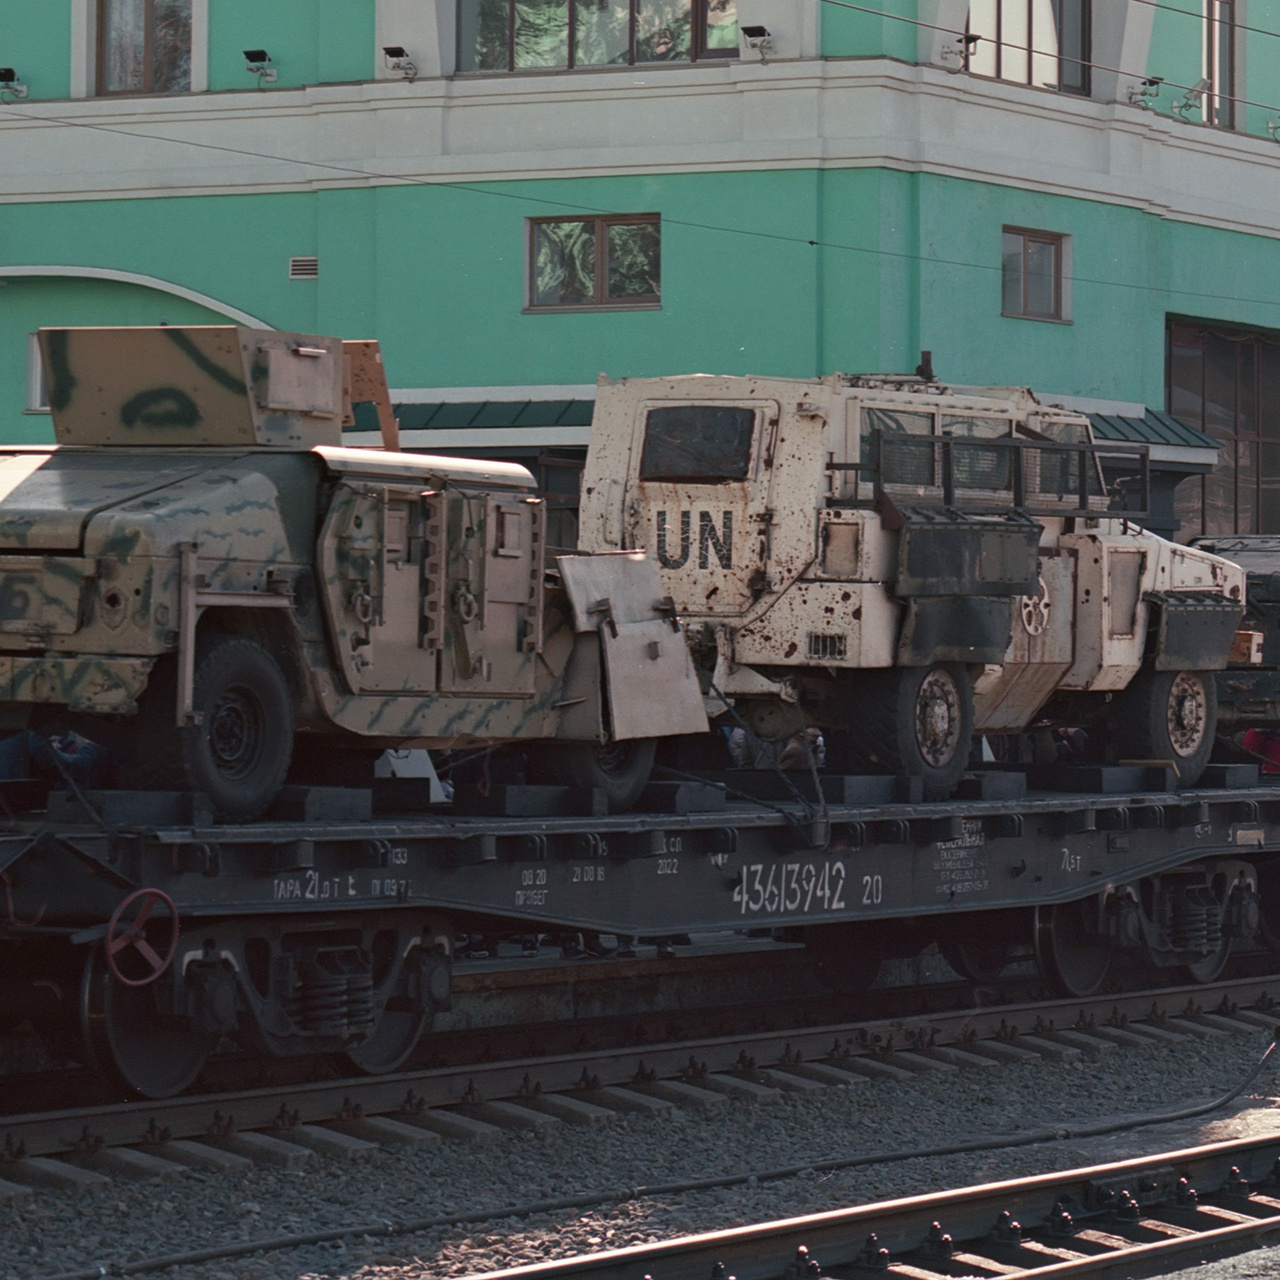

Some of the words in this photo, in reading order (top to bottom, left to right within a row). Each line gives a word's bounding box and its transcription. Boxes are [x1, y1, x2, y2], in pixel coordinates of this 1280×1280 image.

[657, 510, 733, 570] UN
[273, 878, 301, 900] ТАРА
[733, 861, 846, 915] 43613942
[862, 874, 882, 905] 20
